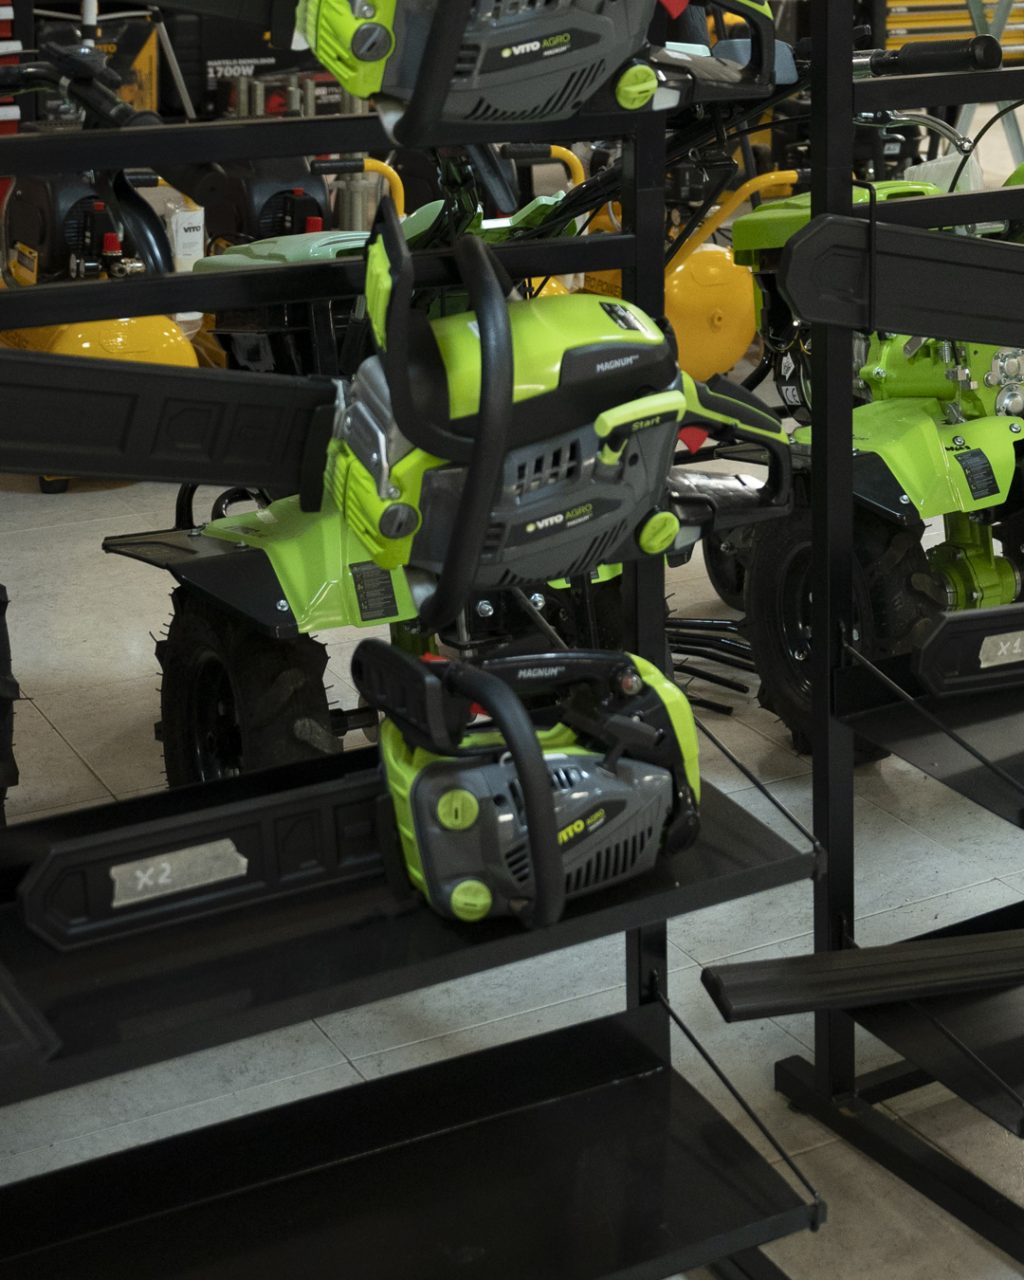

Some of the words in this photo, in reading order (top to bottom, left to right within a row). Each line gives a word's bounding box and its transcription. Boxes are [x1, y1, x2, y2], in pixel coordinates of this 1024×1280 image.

[512, 40, 540, 55] VITO
[542, 33, 571, 48] AGRO
[207, 65, 255, 78] 1700W
[183, 225, 202, 233] VITO
[596, 356, 633, 373] MAGNUM
[632, 415, 661, 431] Start
[535, 514, 564, 530] VITO
[565, 503, 593, 520] AGRO
[518, 667, 559, 679] MAGNUM
